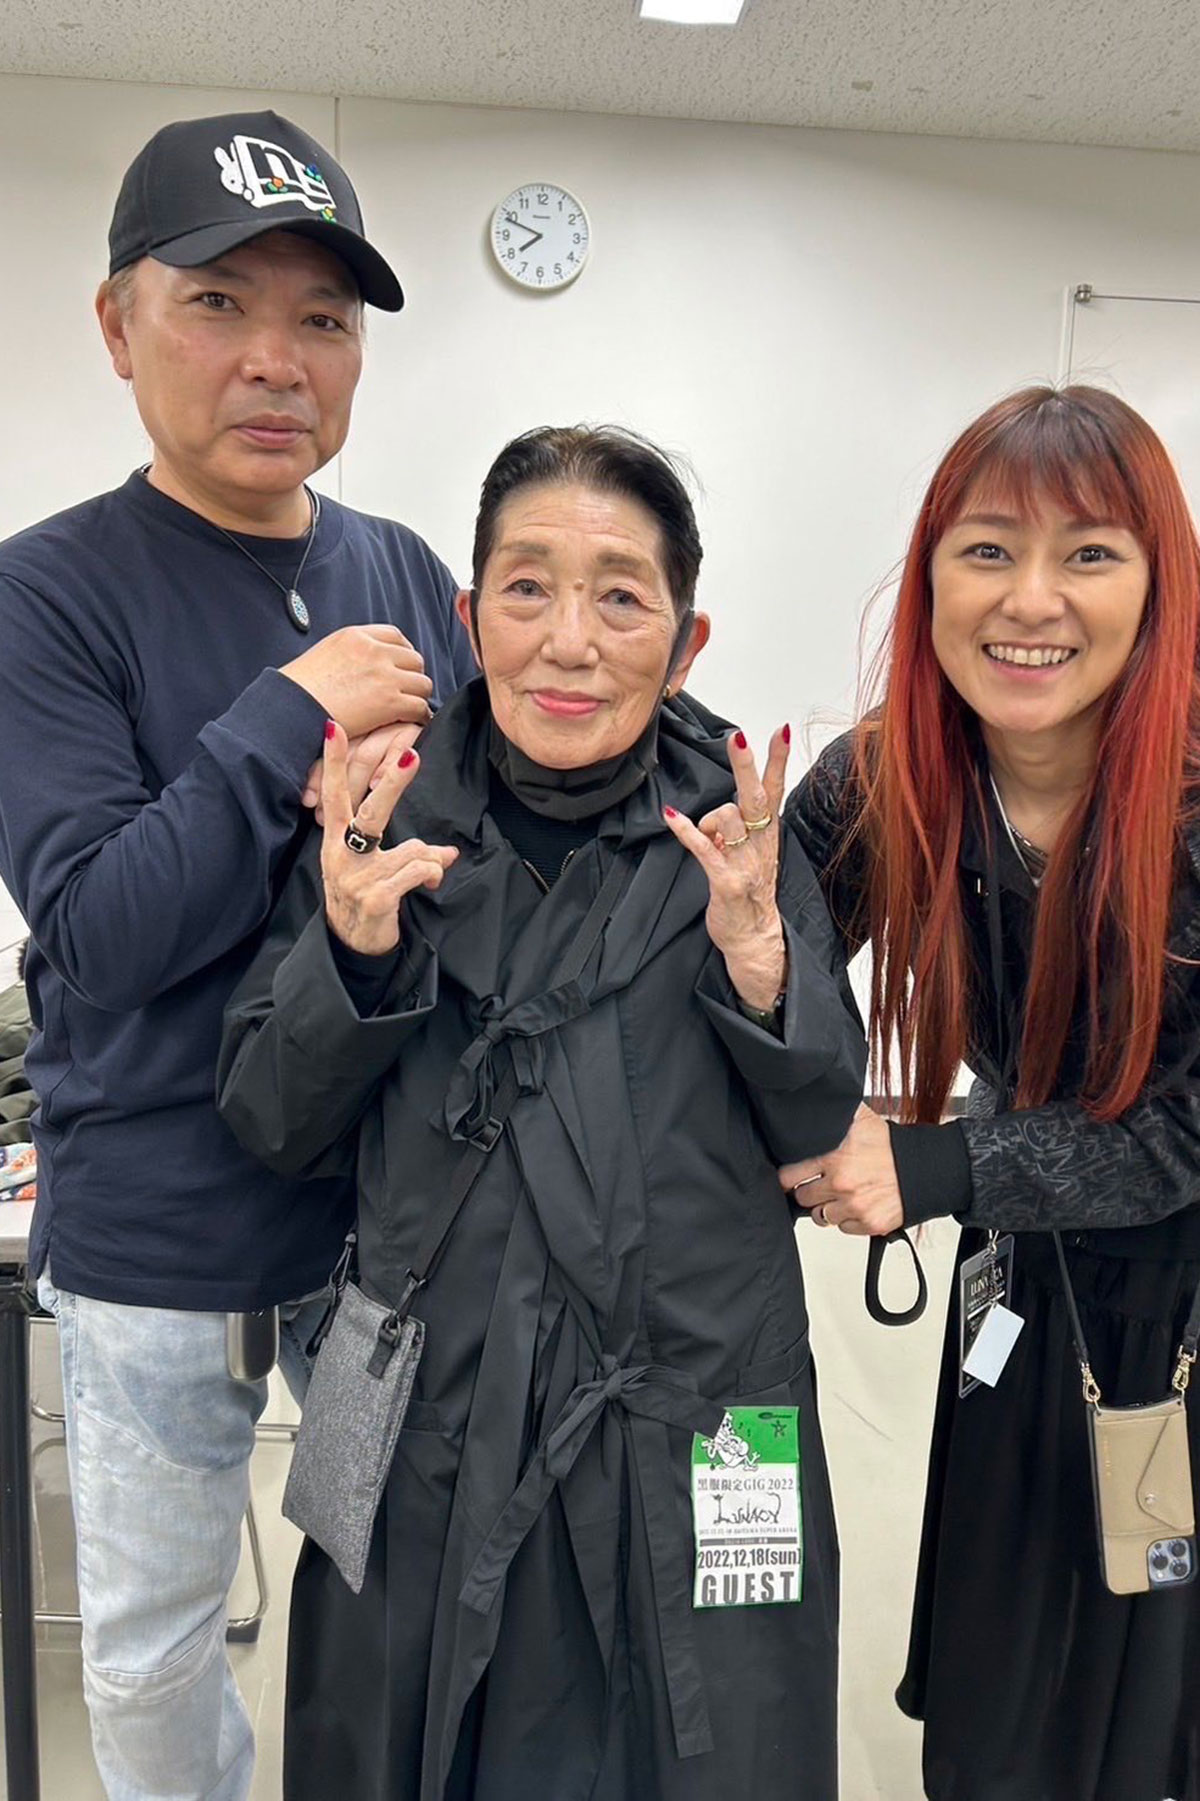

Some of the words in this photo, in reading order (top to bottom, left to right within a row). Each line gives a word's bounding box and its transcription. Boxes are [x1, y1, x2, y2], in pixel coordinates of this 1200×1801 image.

[519, 198, 529, 210] 11
[537, 193, 549, 206] 12
[558, 200, 563, 212] 1
[568, 213, 577, 226] 2
[502, 229, 511, 241] 9
[572, 232, 581, 245] 3
[507, 247, 516, 260] 8
[567, 251, 576, 262] 4
[520, 261, 529, 273] 7
[536, 266, 545, 278] 6
[553, 262, 562, 275] 5
[767, 1478, 794, 1490] 2022
[701, 1571, 795, 1605] GUEST
